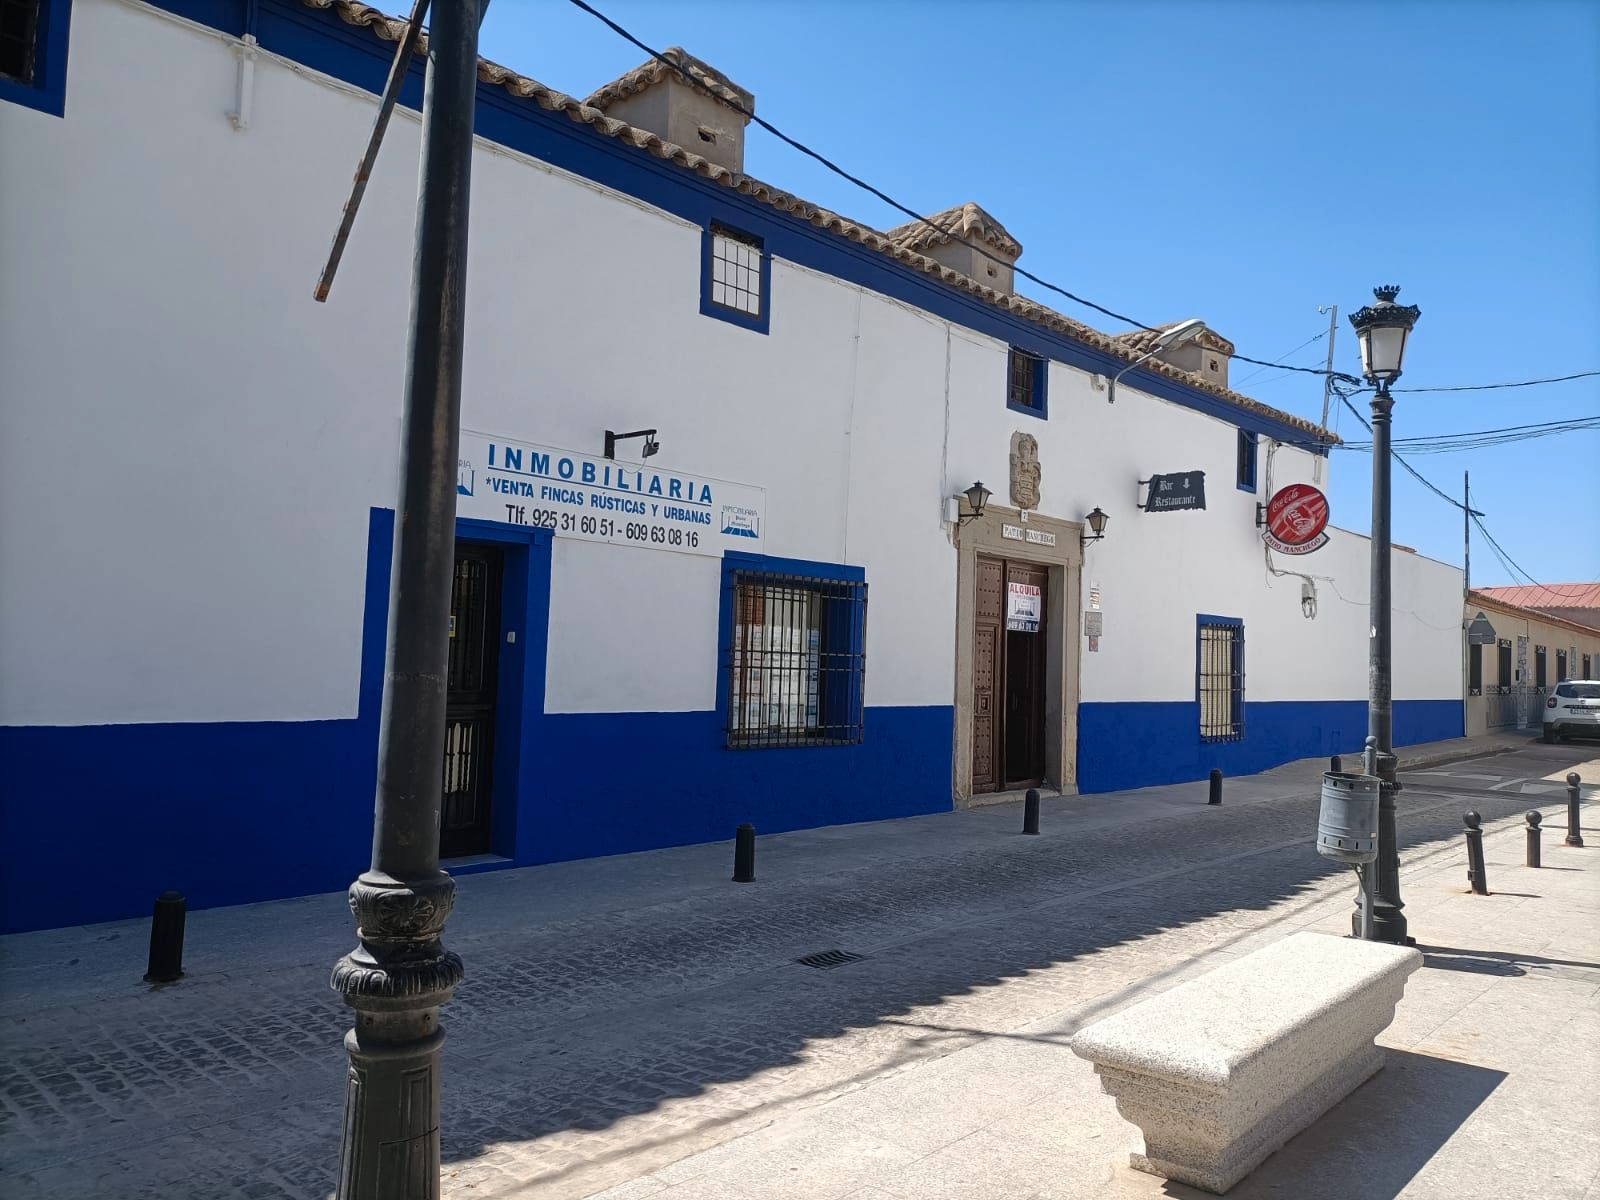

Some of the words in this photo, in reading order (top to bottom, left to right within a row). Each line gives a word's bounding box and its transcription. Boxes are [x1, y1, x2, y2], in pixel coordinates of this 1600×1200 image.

[488, 444, 713, 503] INMOBILIARIA
[1159, 480, 1174, 491] Bar
[541, 486, 584, 506] FINCAS
[590, 491, 646, 515] RÚSTICAS
[651, 504, 659, 517] Y
[663, 505, 712, 525] URBANAS
[1154, 495, 1196, 507] Restaurante
[505, 503, 528, 525] Tlf.
[532, 508, 558, 529] 925
[560, 512, 576, 532] 31
[580, 515, 597, 535] 60
[599, 518, 614, 537] 51
[625, 522, 648, 541] 609
[650, 525, 666, 544] 63
[668, 528, 682, 546] 08
[685, 530, 699, 547] 16
[1265, 535, 1282, 550] PATIO
[1283, 537, 1321, 553] MANCHEGO
[1009, 583, 1040, 597] ALQUILA
